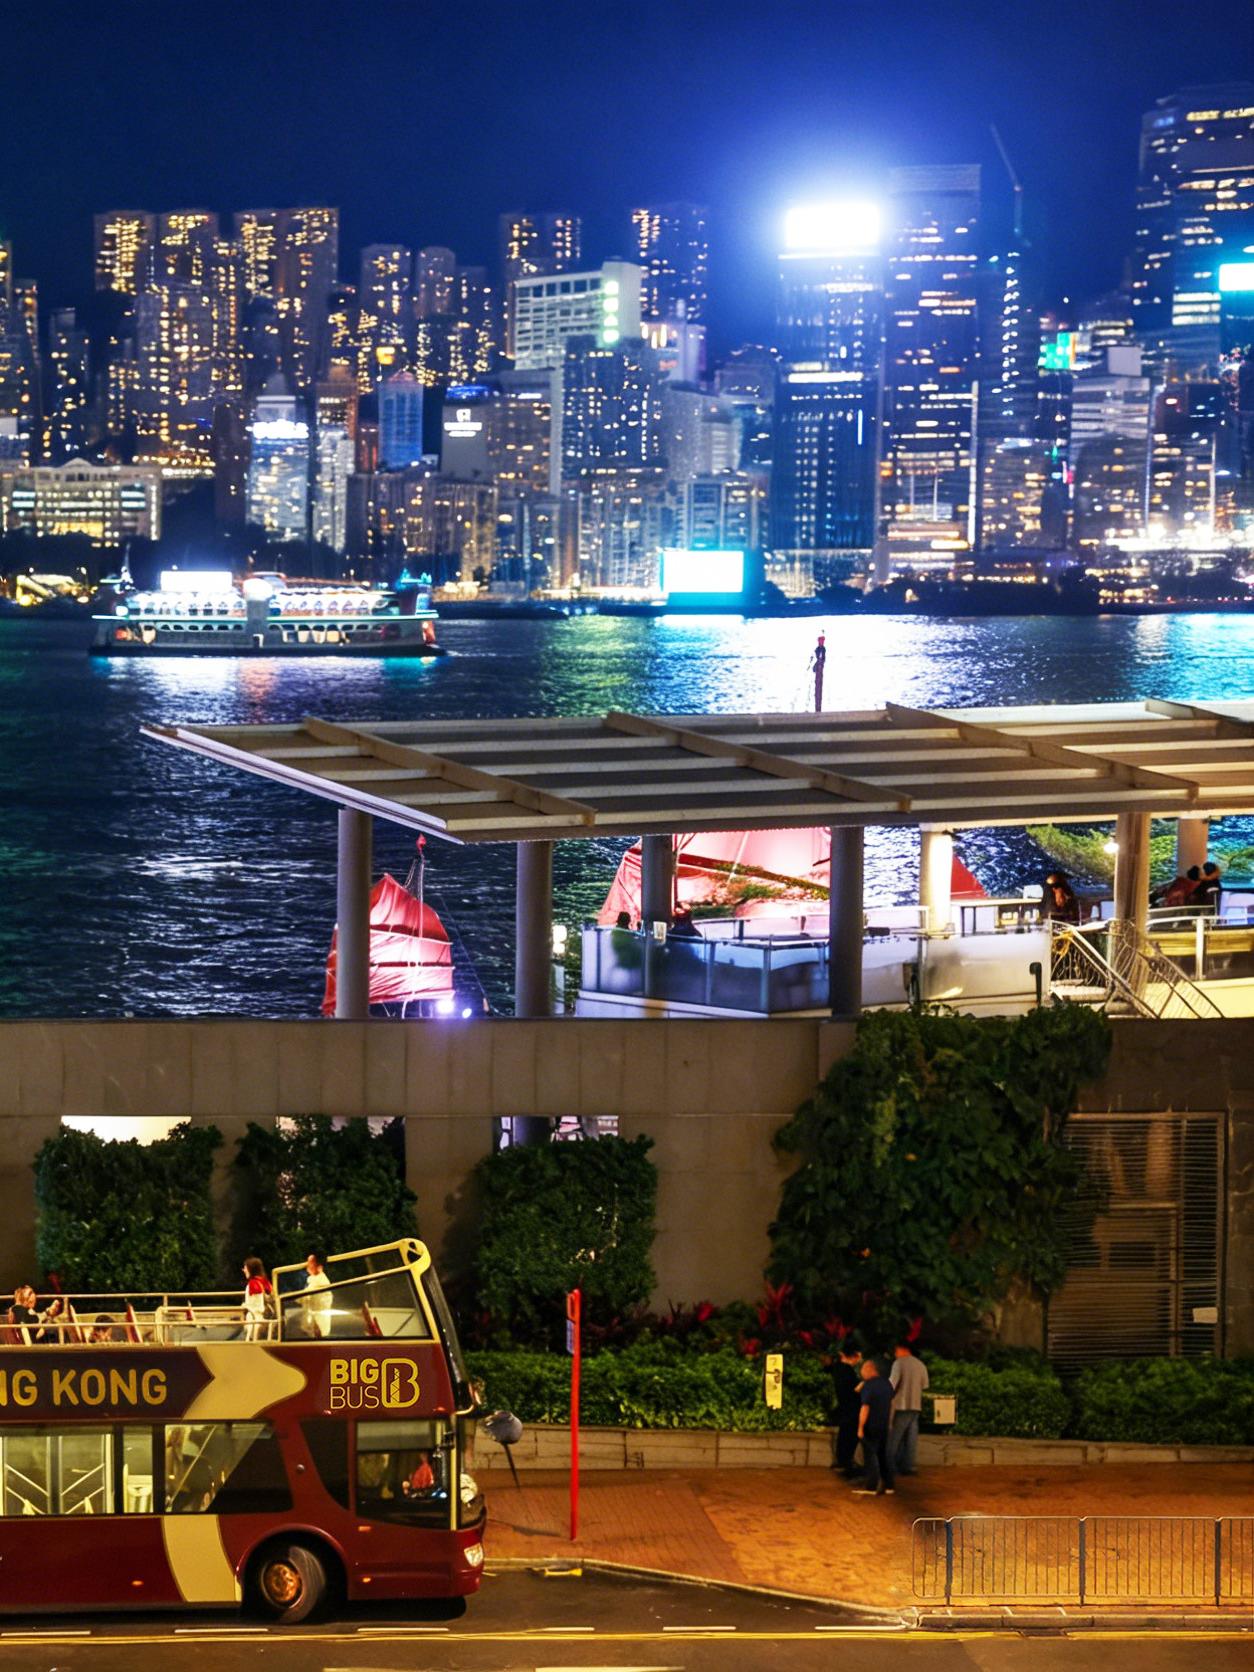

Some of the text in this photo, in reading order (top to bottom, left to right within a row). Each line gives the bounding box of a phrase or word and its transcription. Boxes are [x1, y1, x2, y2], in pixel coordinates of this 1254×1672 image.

[330, 1358, 379, 1384] BIG
[52, 1368, 167, 1406] KONG
[330, 1385, 380, 1409] BUS
